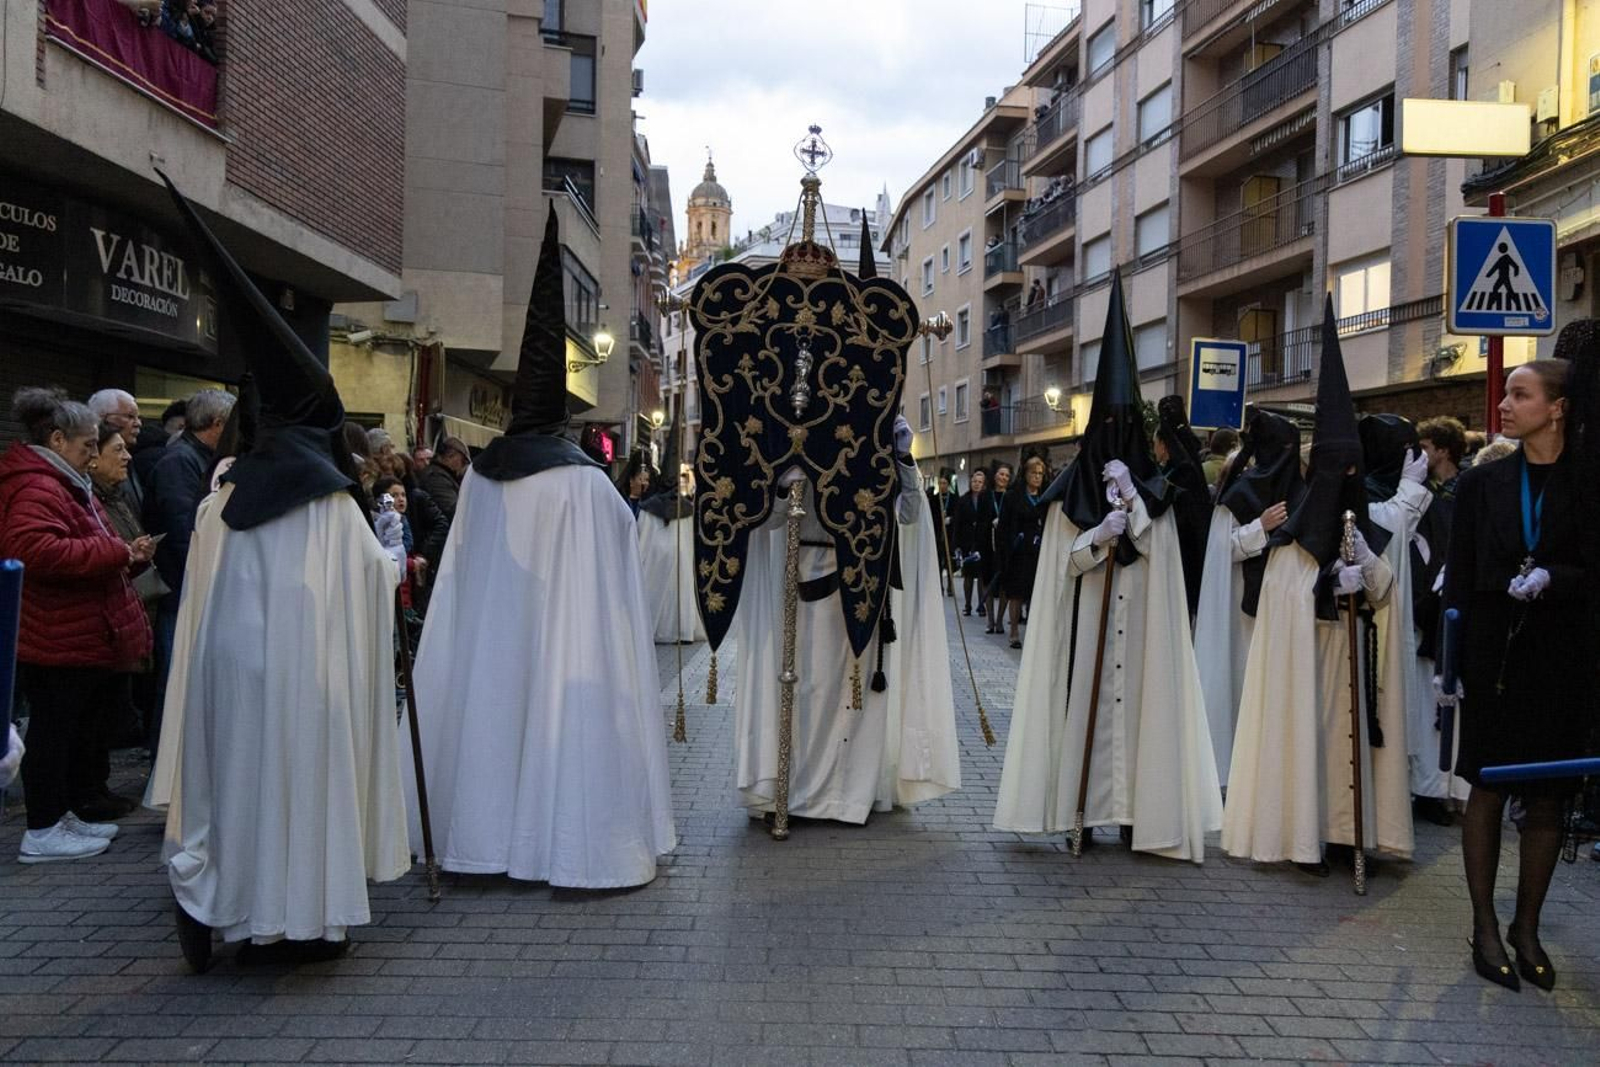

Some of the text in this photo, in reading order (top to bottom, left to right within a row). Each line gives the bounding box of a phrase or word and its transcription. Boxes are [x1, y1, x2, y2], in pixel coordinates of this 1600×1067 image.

[0, 202, 57, 232] CULOS
[90, 227, 190, 301] VAREL
[111, 285, 178, 318] DECORACIÓN
